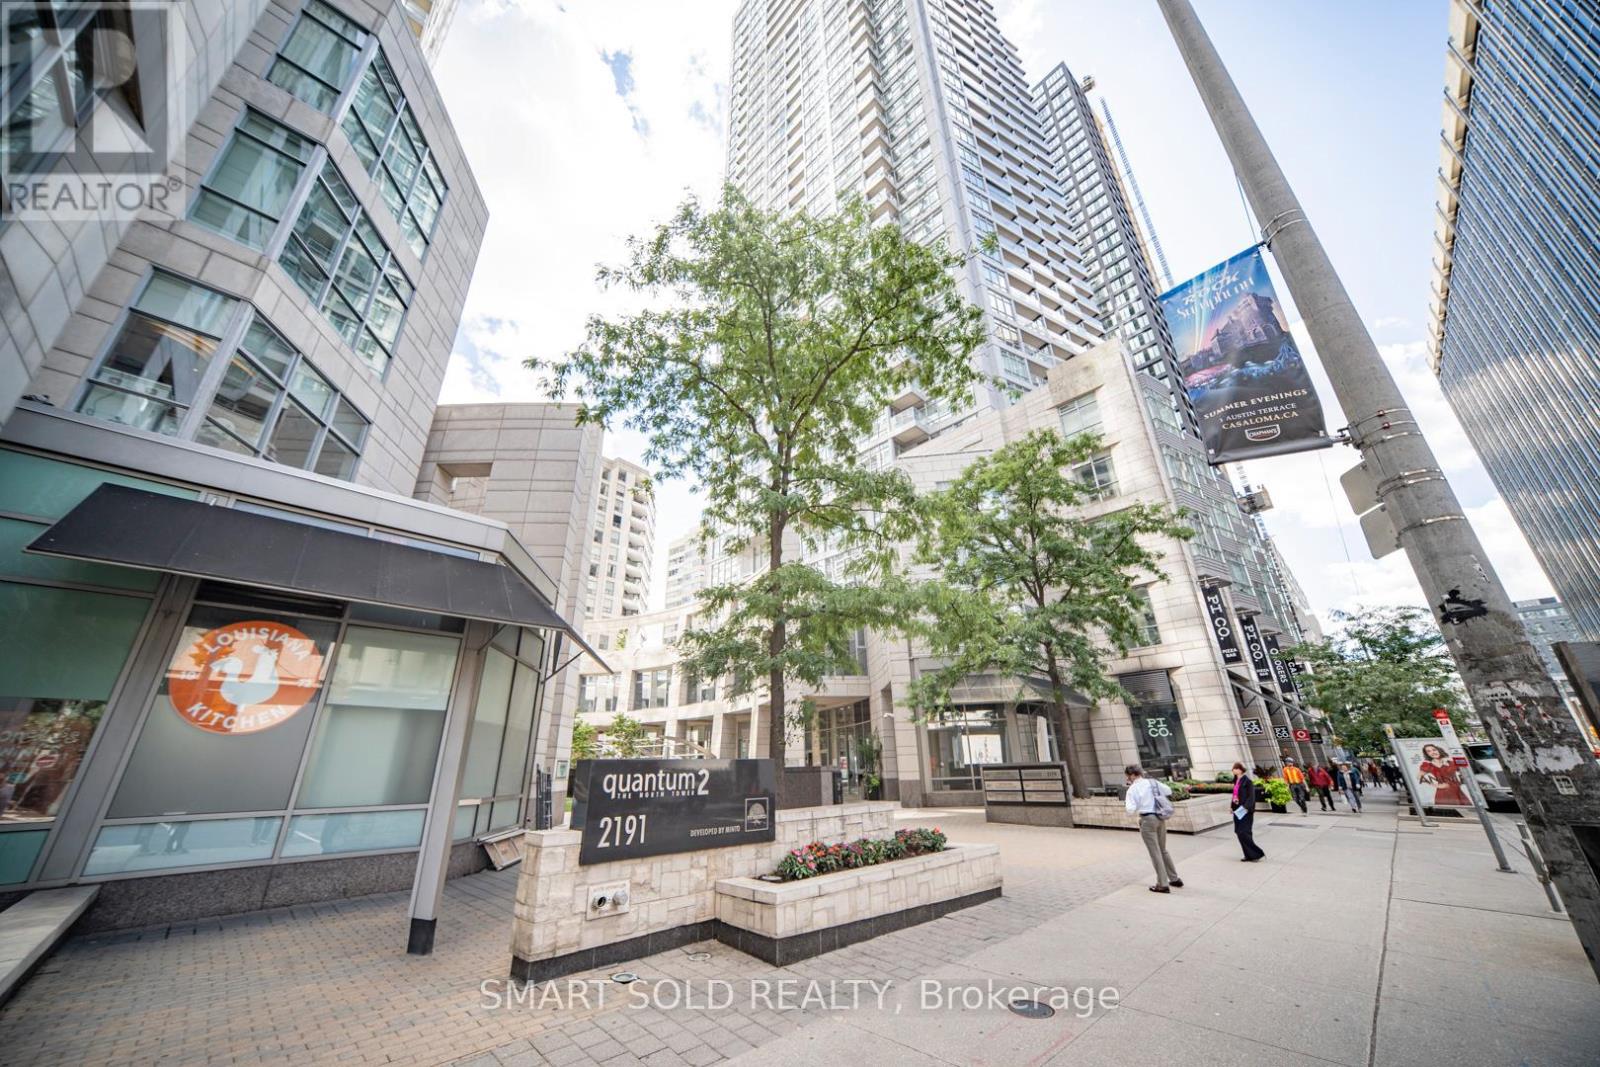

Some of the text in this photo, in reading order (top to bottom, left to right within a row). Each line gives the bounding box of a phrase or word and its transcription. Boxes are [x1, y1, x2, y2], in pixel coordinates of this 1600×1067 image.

[1203, 388, 1308, 420] SUMMER EVENINGS
[1226, 410, 1257, 422] AUSTIN
[1257, 402, 1297, 415] TERRACE
[1222, 410, 1299, 430] CASALOMA.CA
[1207, 594, 1230, 640] PI CO.
[204, 627, 311, 662] LOUISIANA
[1244, 624, 1263, 662] PI CO.
[1273, 657, 1288, 684] OGERS
[186, 701, 288, 730] KITCHEN
[1146, 717, 1167, 728] PI
[1243, 720, 1258, 728] PI
[1148, 727, 1173, 738] CO.
[617, 789, 696, 800] THE NORTH TOWER
[596, 814, 647, 849] 2191
[689, 825, 741, 838] DEVELOPED BY MINTO
